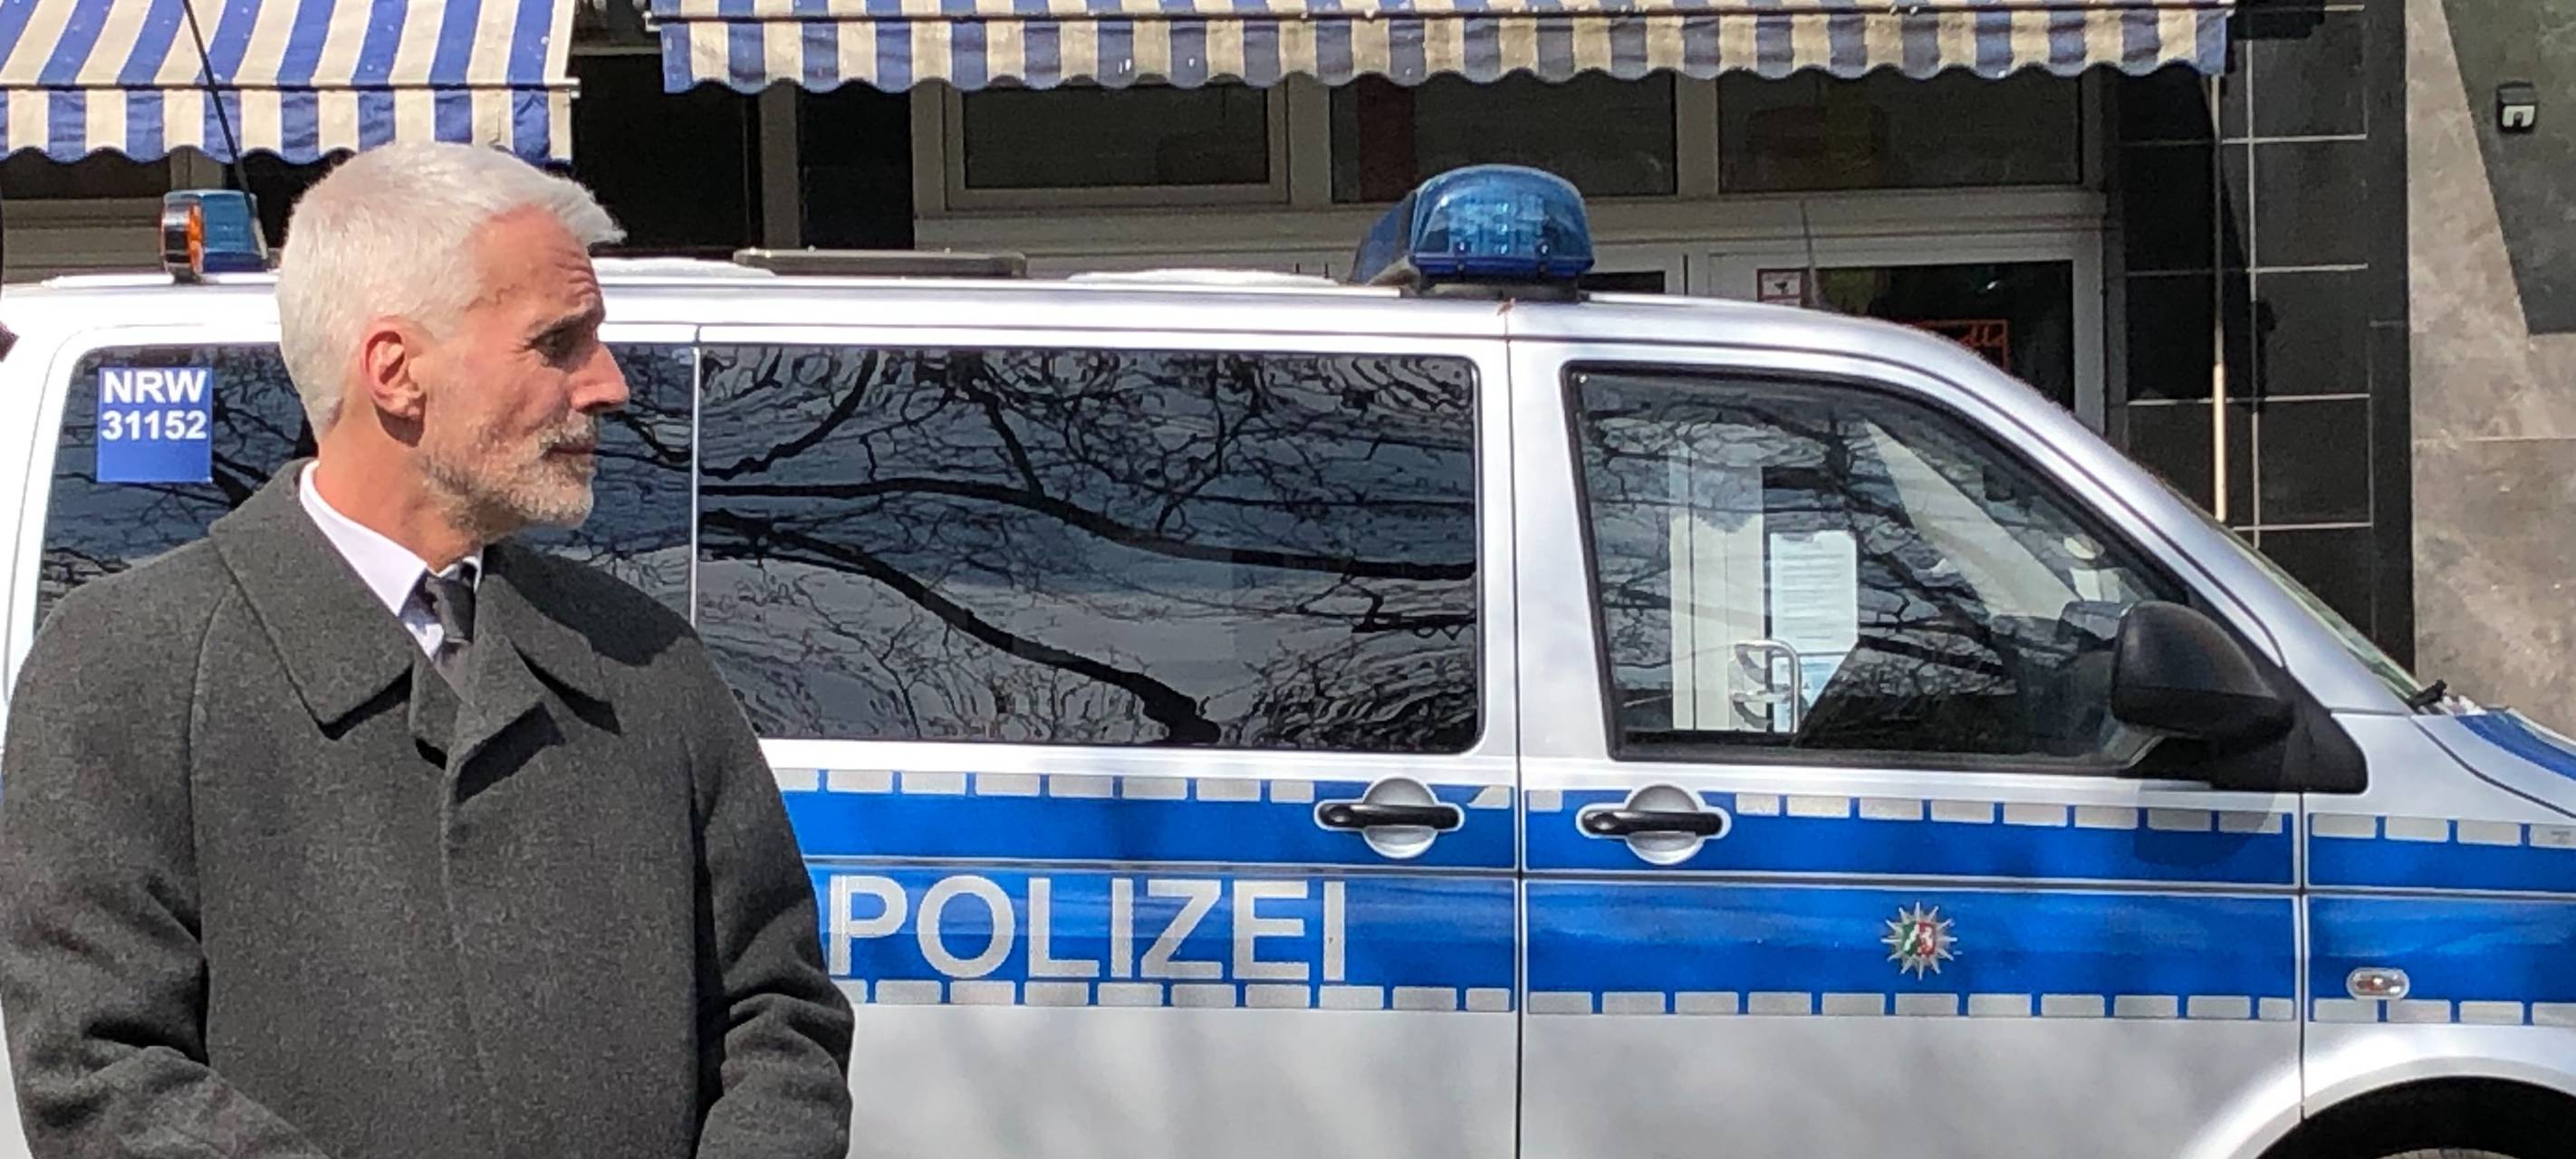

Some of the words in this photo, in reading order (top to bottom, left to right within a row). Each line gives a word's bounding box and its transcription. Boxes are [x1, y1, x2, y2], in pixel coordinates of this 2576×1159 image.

[104, 370, 207, 404] NRW
[101, 409, 207, 441] 31152
[828, 875, 1346, 982] POLIZEI
